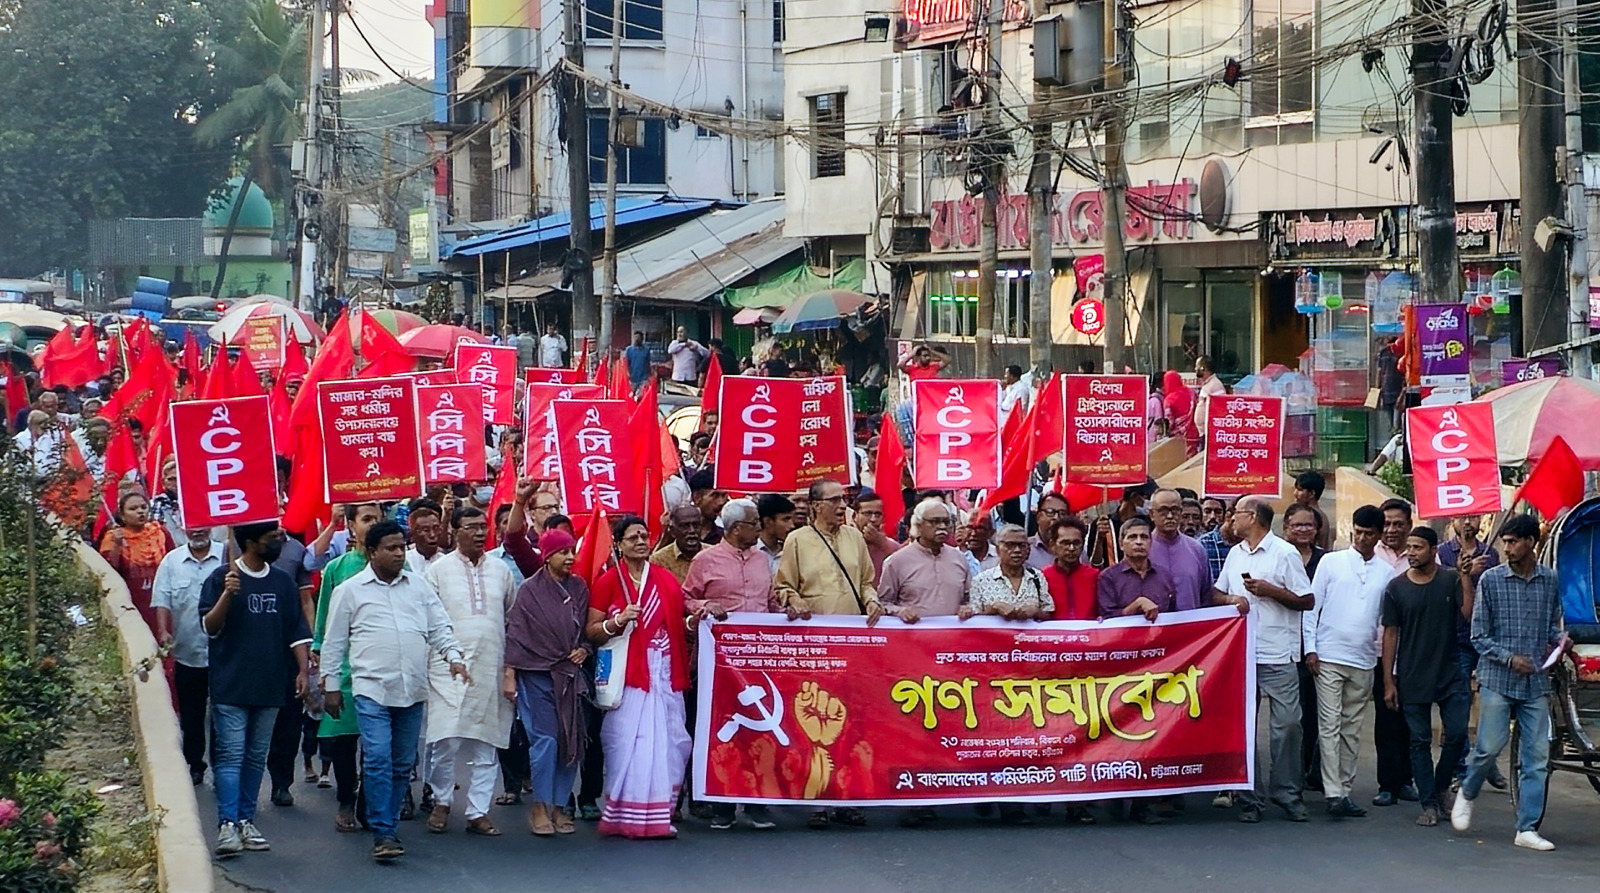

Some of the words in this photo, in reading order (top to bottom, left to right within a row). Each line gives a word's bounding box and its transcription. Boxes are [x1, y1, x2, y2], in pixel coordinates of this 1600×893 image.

[329, 385, 403, 402] মাজার-মন্দির
[1089, 379, 1123, 395] বিশেষ
[340, 405, 358, 416] সহ
[334, 416, 399, 431] উপাসনালয়ে
[1074, 412, 1142, 428] হত্যাকারীদের
[1213, 414, 1242, 429] জাতীয়
[340, 433, 374, 446] হামলা
[377, 431, 396, 443] বন্ধ
[738, 404, 777, 484] CPB
[936, 405, 973, 481] CPB
[1076, 429, 1107, 444] বিচার
[1216, 430, 1237, 443] নিয়ে
[426, 409, 468, 481] সিপিবি
[1251, 449, 1268, 458] কর
[200, 427, 250, 517] CPB
[1431, 429, 1474, 509] CPB
[936, 652, 954, 664] দ্রুত
[989, 652, 1008, 662] করে
[1012, 649, 1056, 662] নির্বাচনের
[1060, 652, 1082, 662] রোড
[1085, 651, 1107, 661] ম্যাপ
[1141, 648, 1165, 659] করুন
[890, 674, 979, 730] গণ
[990, 665, 1204, 741] সমাবেশ
[940, 736, 958, 748] ২৩
[918, 772, 987, 788] বাংলাদেশের
[991, 767, 1055, 786] কমিউনিস্ট
[1060, 764, 1087, 783] পার্টি
[1151, 766, 1178, 780] চট্টগ্রাম
[1182, 763, 1203, 776] জেলা
